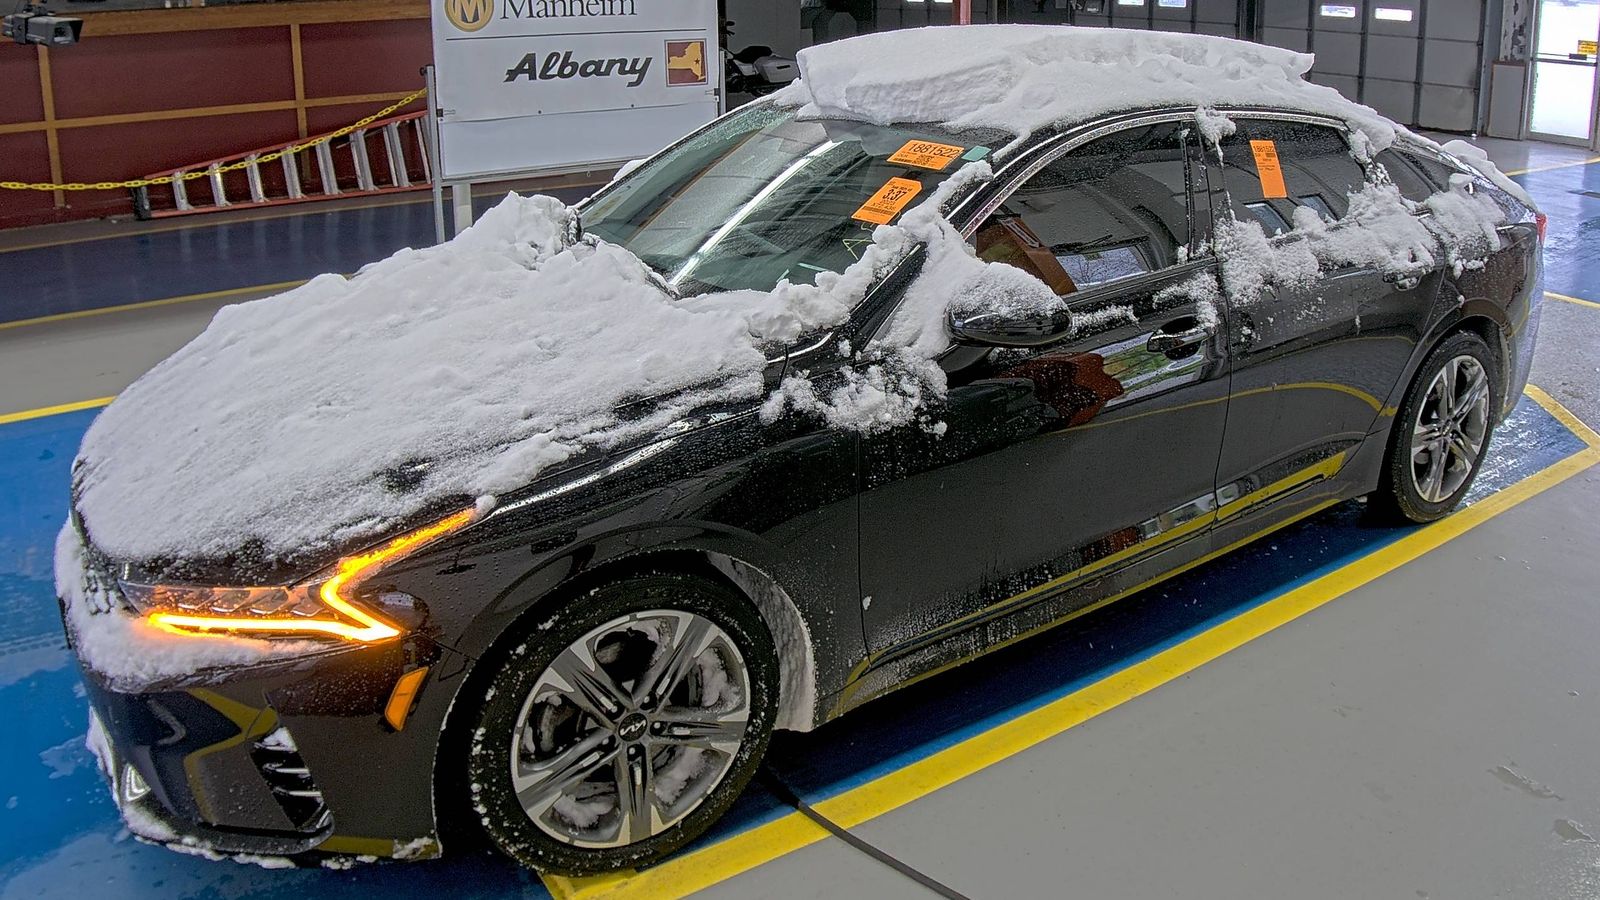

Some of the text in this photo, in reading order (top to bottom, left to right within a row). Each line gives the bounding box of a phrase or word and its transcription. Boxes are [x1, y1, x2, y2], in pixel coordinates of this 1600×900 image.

[500, 0, 637, 20] Manheim
[503, 50, 652, 87] Albany
[909, 143, 960, 158] 1881522
[882, 188, 907, 201] 3:37
